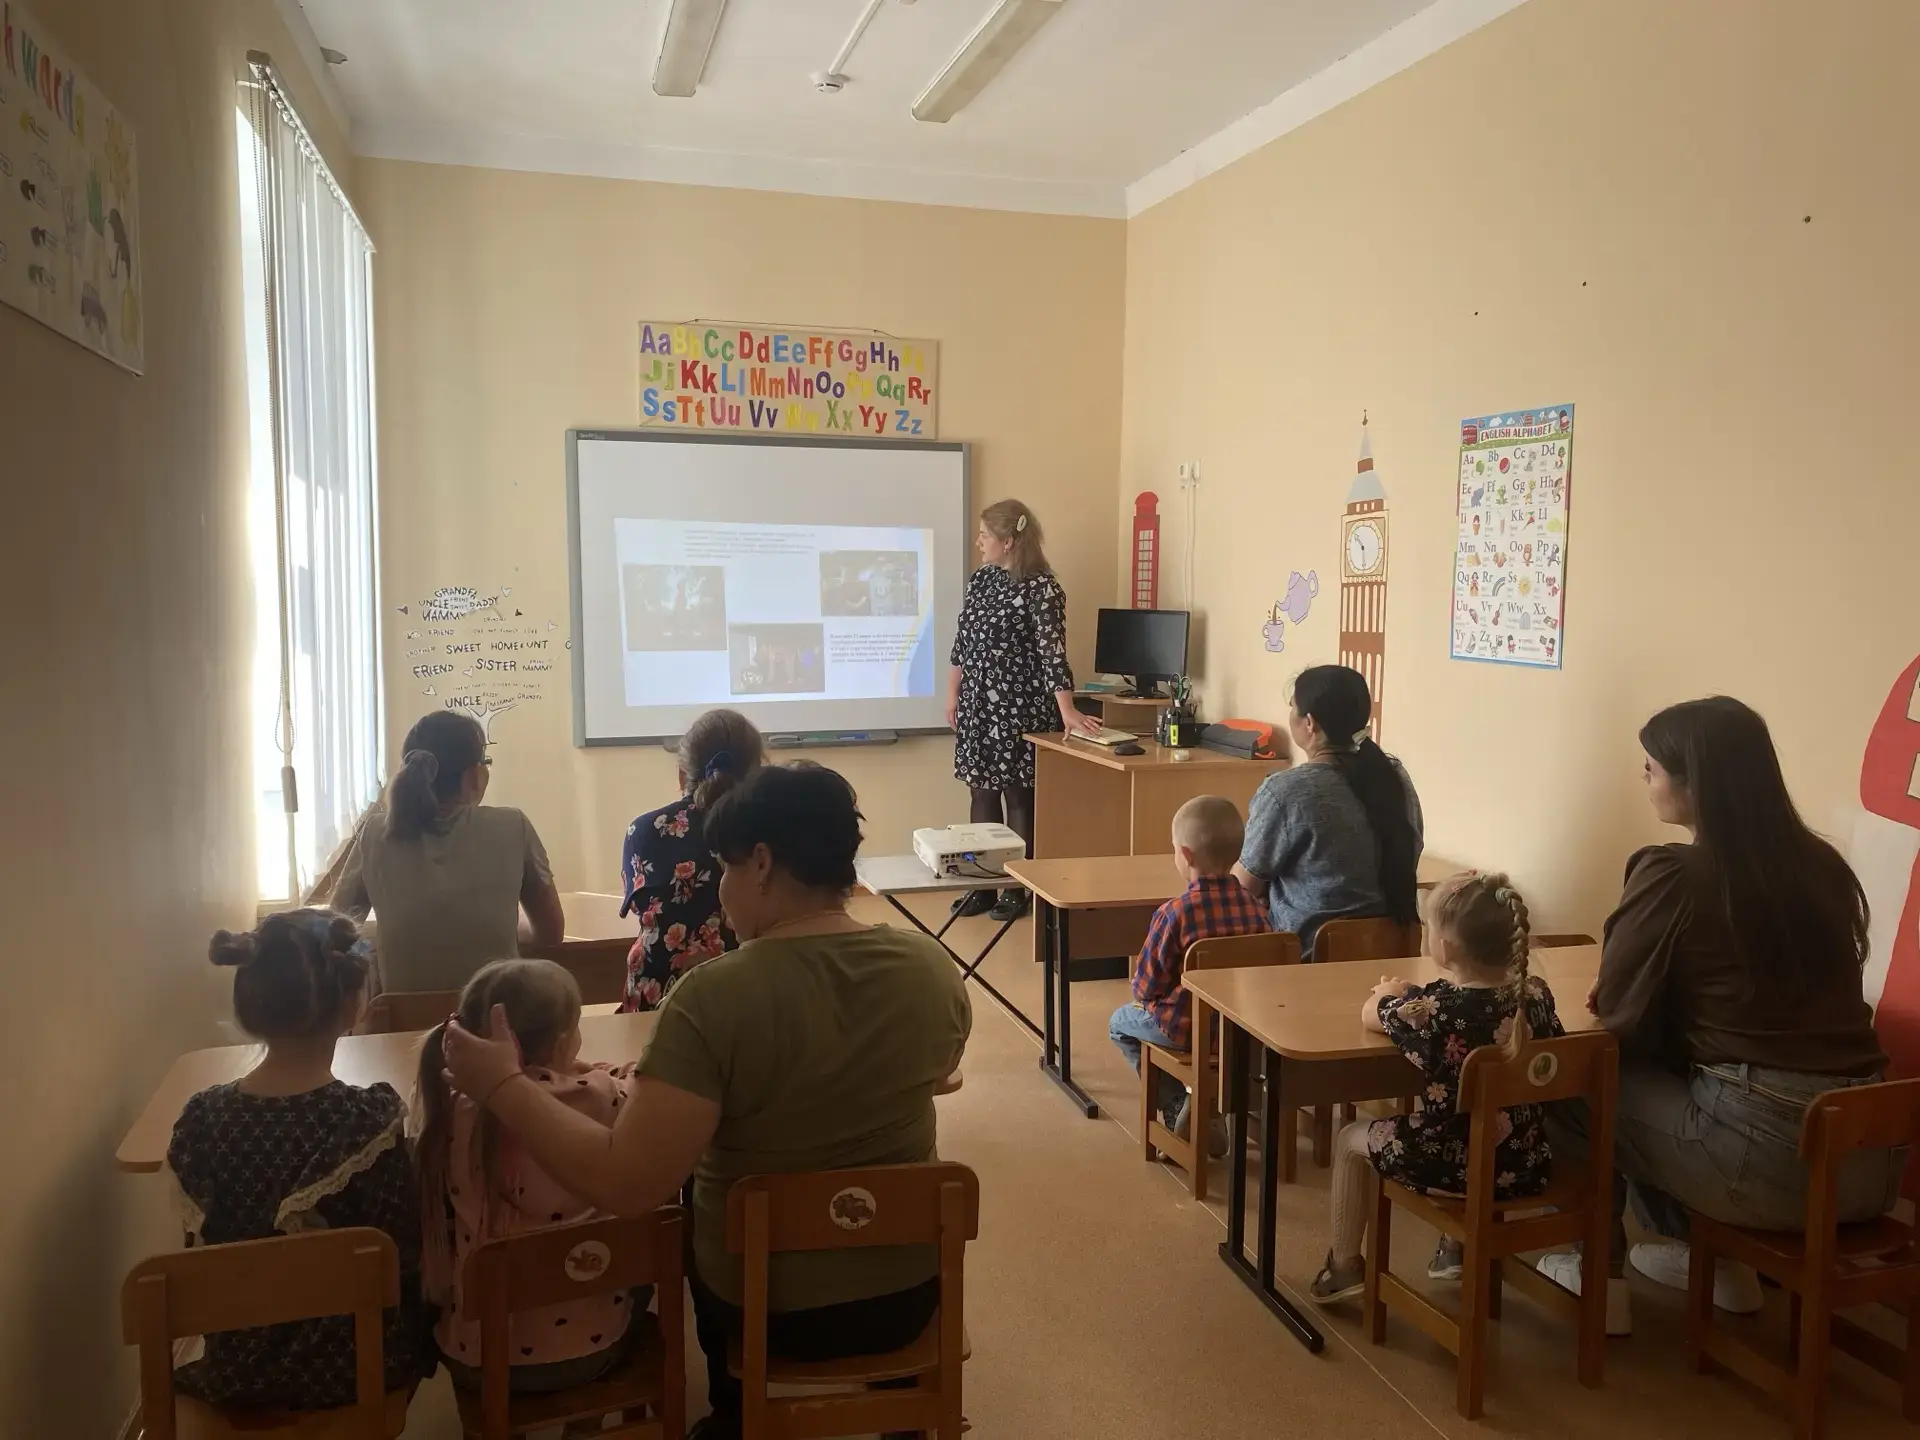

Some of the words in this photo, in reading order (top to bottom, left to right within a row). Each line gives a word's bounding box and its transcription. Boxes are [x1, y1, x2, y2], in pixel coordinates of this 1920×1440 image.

[639, 323, 672, 356] Aa
[704, 329, 734, 361] Cc
[739, 331, 770, 363] Dd
[774, 334, 806, 363] Ee
[809, 336, 834, 368] Ff
[837, 339, 867, 372] Gg
[870, 341, 899, 372] Hh
[640, 359, 675, 391] Jj
[680, 359, 718, 394] Kk
[749, 367, 785, 399] Mm
[787, 366, 814, 399] Nn
[815, 370, 845, 399] Oo
[876, 374, 906, 406] Qq
[907, 376, 931, 405] Rr
[643, 388, 677, 423] Ss
[676, 395, 705, 427] Tt
[709, 396, 741, 426] Uu
[748, 399, 779, 428] Vv
[826, 399, 854, 431] Xx
[858, 404, 887, 434] Yy
[895, 409, 923, 435] Zz
[1480, 428, 1511, 442] ENGLISH
[1512, 423, 1553, 438] ALPHABET
[446, 643, 481, 654] SWEET
[490, 641, 519, 651] HOME
[413, 664, 454, 679] FRIEND
[475, 658, 517, 672] SISTER
[444, 695, 482, 709] UNCLE
